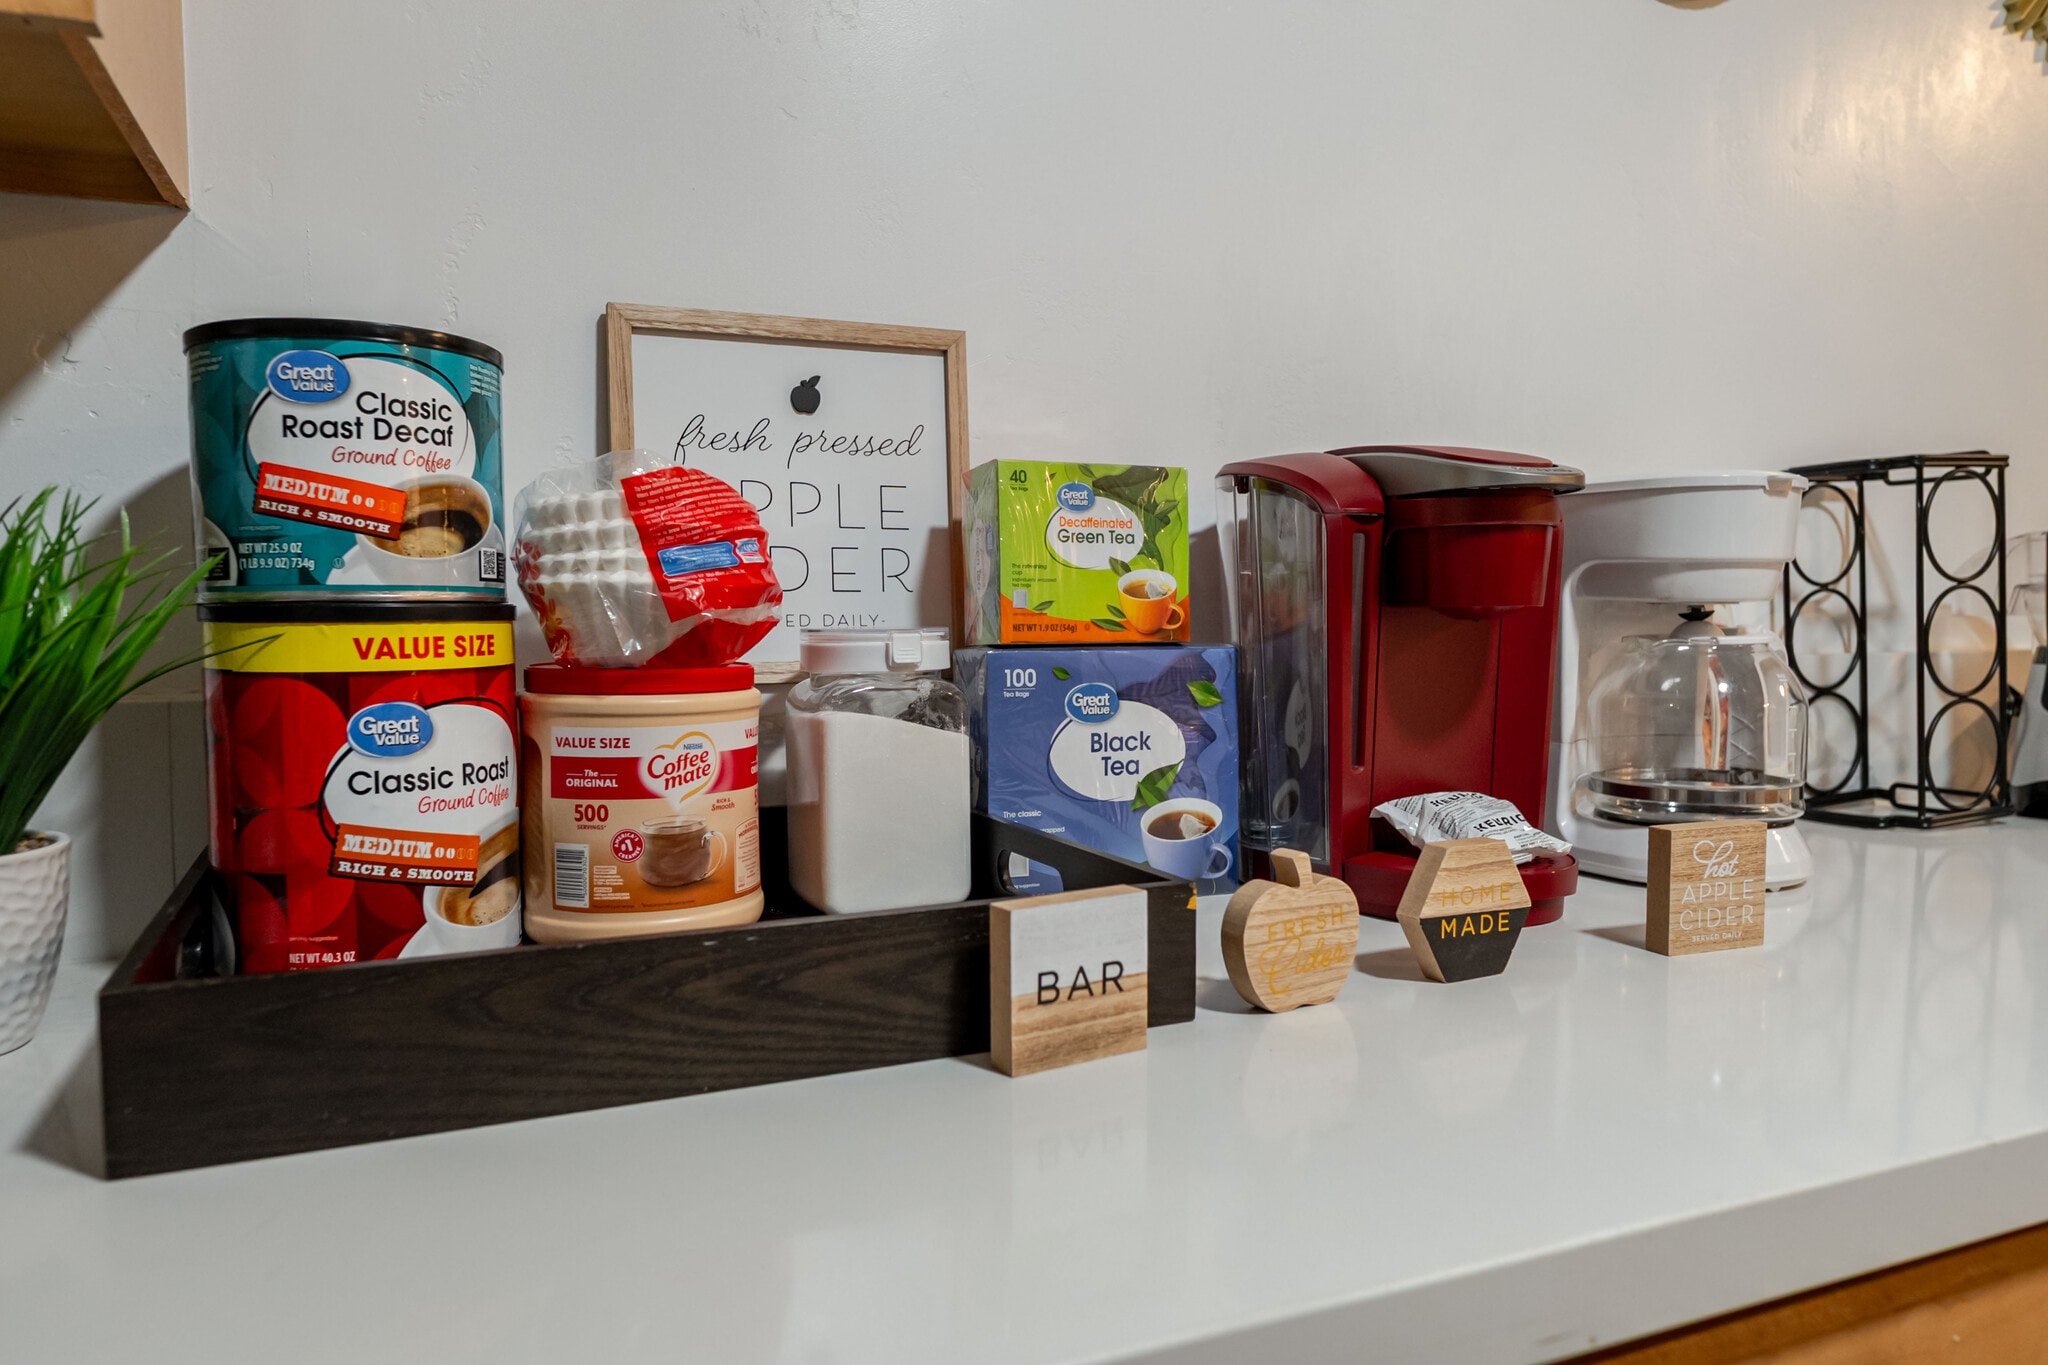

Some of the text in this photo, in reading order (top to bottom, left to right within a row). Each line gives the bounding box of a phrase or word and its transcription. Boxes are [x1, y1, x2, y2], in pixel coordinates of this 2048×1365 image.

[277, 362, 334, 381] Great
[291, 378, 335, 393] Value
[356, 391, 452, 423] Classic
[282, 414, 453, 447] Roast Decaf
[673, 414, 924, 470] fresh pressed
[331, 446, 452, 472] Ground Coffee
[1009, 469, 1027, 484] 40
[263, 473, 350, 505] MEDIUM
[1061, 488, 1089, 500] Great
[740, 479, 910, 531] PPLE
[1067, 498, 1089, 506] Value
[259, 499, 391, 534] RICH & SMOOTH
[1059, 516, 1133, 529] Decaffeinated
[1057, 529, 1135, 545] Green Tea
[238, 543, 303, 554] NET WT 25.9 OZ
[291, 558, 315, 570] 734g
[769, 545, 914, 593] DER
[1012, 623, 1078, 634] NET WT 1.9 OZ (54g)
[352, 633, 495, 661] VALUE SIZE
[1004, 668, 1037, 688] 100
[1072, 692, 1110, 707] Great
[1081, 704, 1110, 716] Value
[358, 715, 419, 735] Great
[374, 732, 420, 747] Value
[555, 737, 631, 749] VALUE SIZE
[1090, 731, 1152, 753] Black
[583, 769, 599, 777] The
[647, 750, 709, 779] Coffee
[1101, 756, 1140, 777] Tea
[347, 755, 510, 796] Classic Roast
[565, 777, 619, 788] ORIGINAL
[664, 763, 711, 791] mate
[418, 783, 510, 815] Ground Coffee
[711, 802, 735, 812] Smooth
[574, 804, 609, 823] 500
[1003, 810, 1042, 819] The classic
[341, 834, 434, 859] MEDIUM
[614, 832, 640, 848] AMERICA'S
[618, 846, 642, 860] CREAMER
[1693, 839, 1739, 879] hot
[337, 861, 475, 882] RICH & SMOOTH
[1442, 882, 1511, 907] HOME
[1681, 879, 1754, 905] APPLE
[1267, 911, 1345, 943] FRESH
[1441, 912, 1510, 939] MADE
[1680, 904, 1754, 931] CIDER
[1692, 933, 1720, 942] SERVED
[289, 951, 356, 964] NET WT 40.3 OZ
[1259, 936, 1348, 996] Cider
[1037, 960, 1125, 1007] BAR
